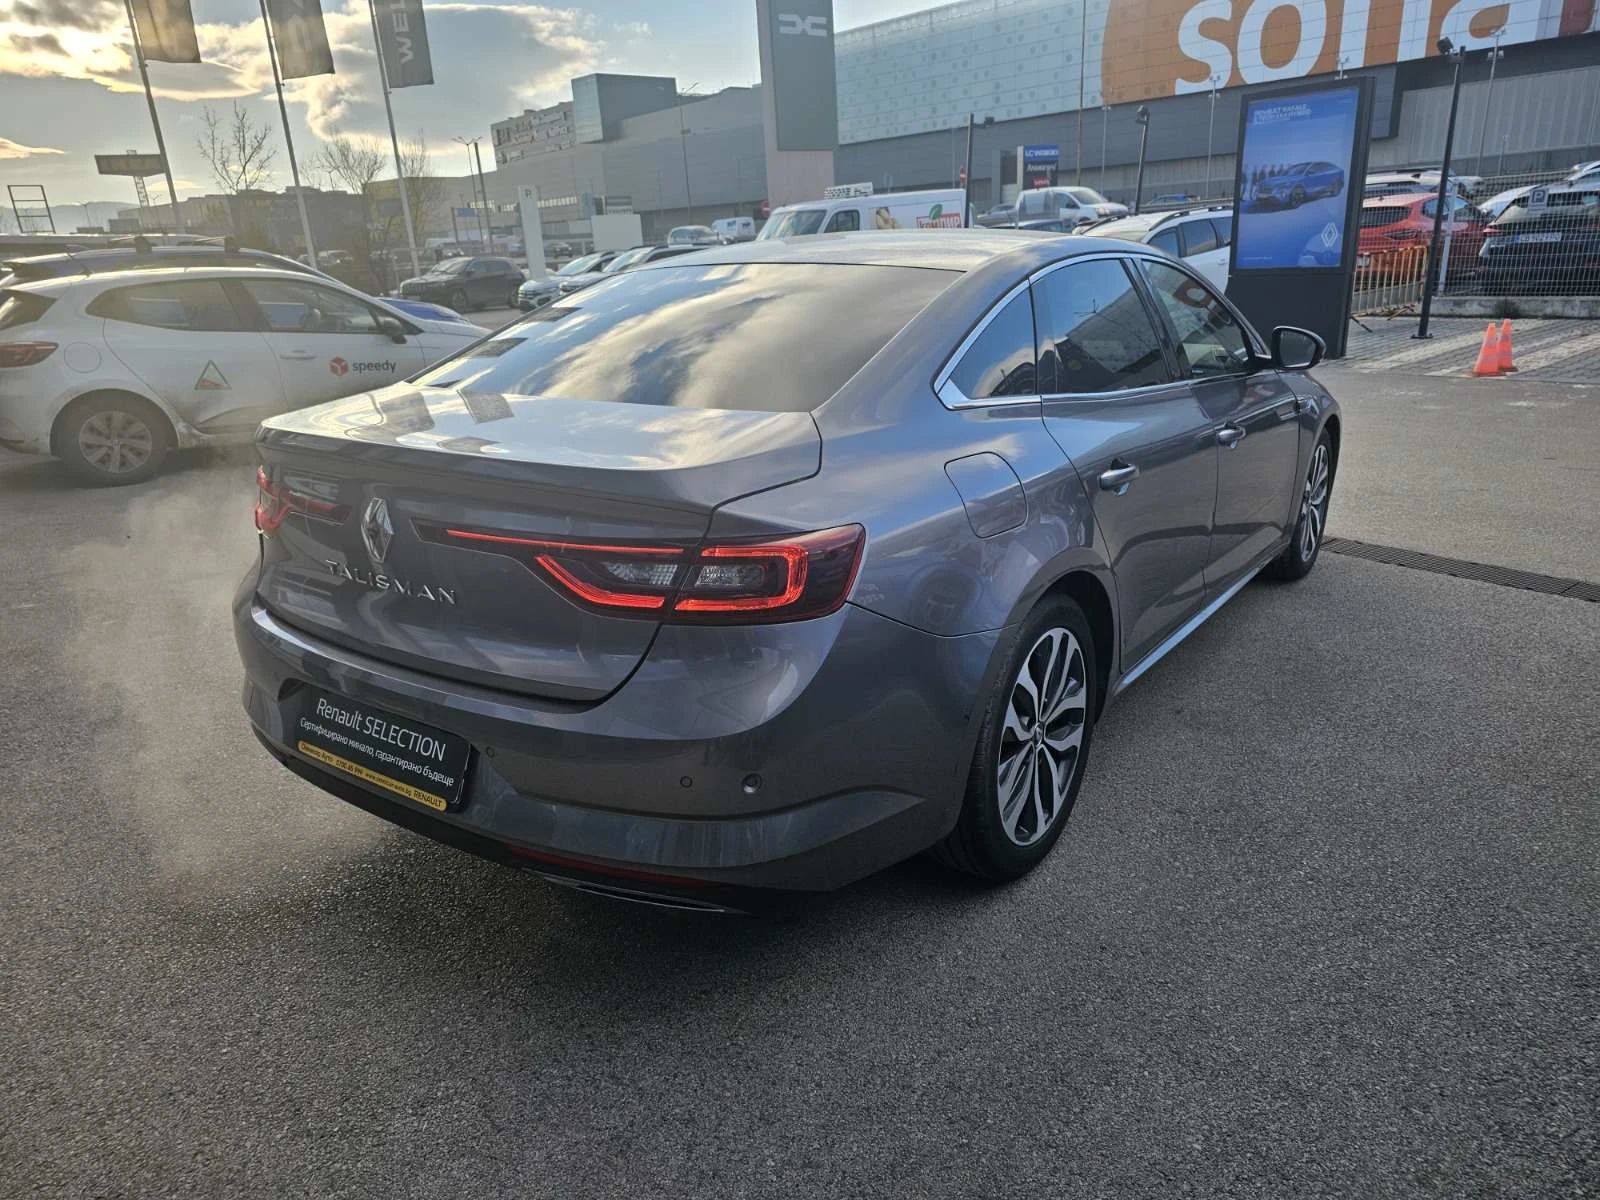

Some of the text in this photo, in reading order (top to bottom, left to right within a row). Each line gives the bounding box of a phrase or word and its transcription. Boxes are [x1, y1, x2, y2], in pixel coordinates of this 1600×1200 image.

[352, 360, 396, 373] speedy
[326, 559, 456, 605] TALISMAN
[300, 717, 454, 787] Сертифицирано минало, гарантирано бъдеще
[316, 698, 446, 762] Renault SELECTION
[414, 788, 443, 808] RENAULT
